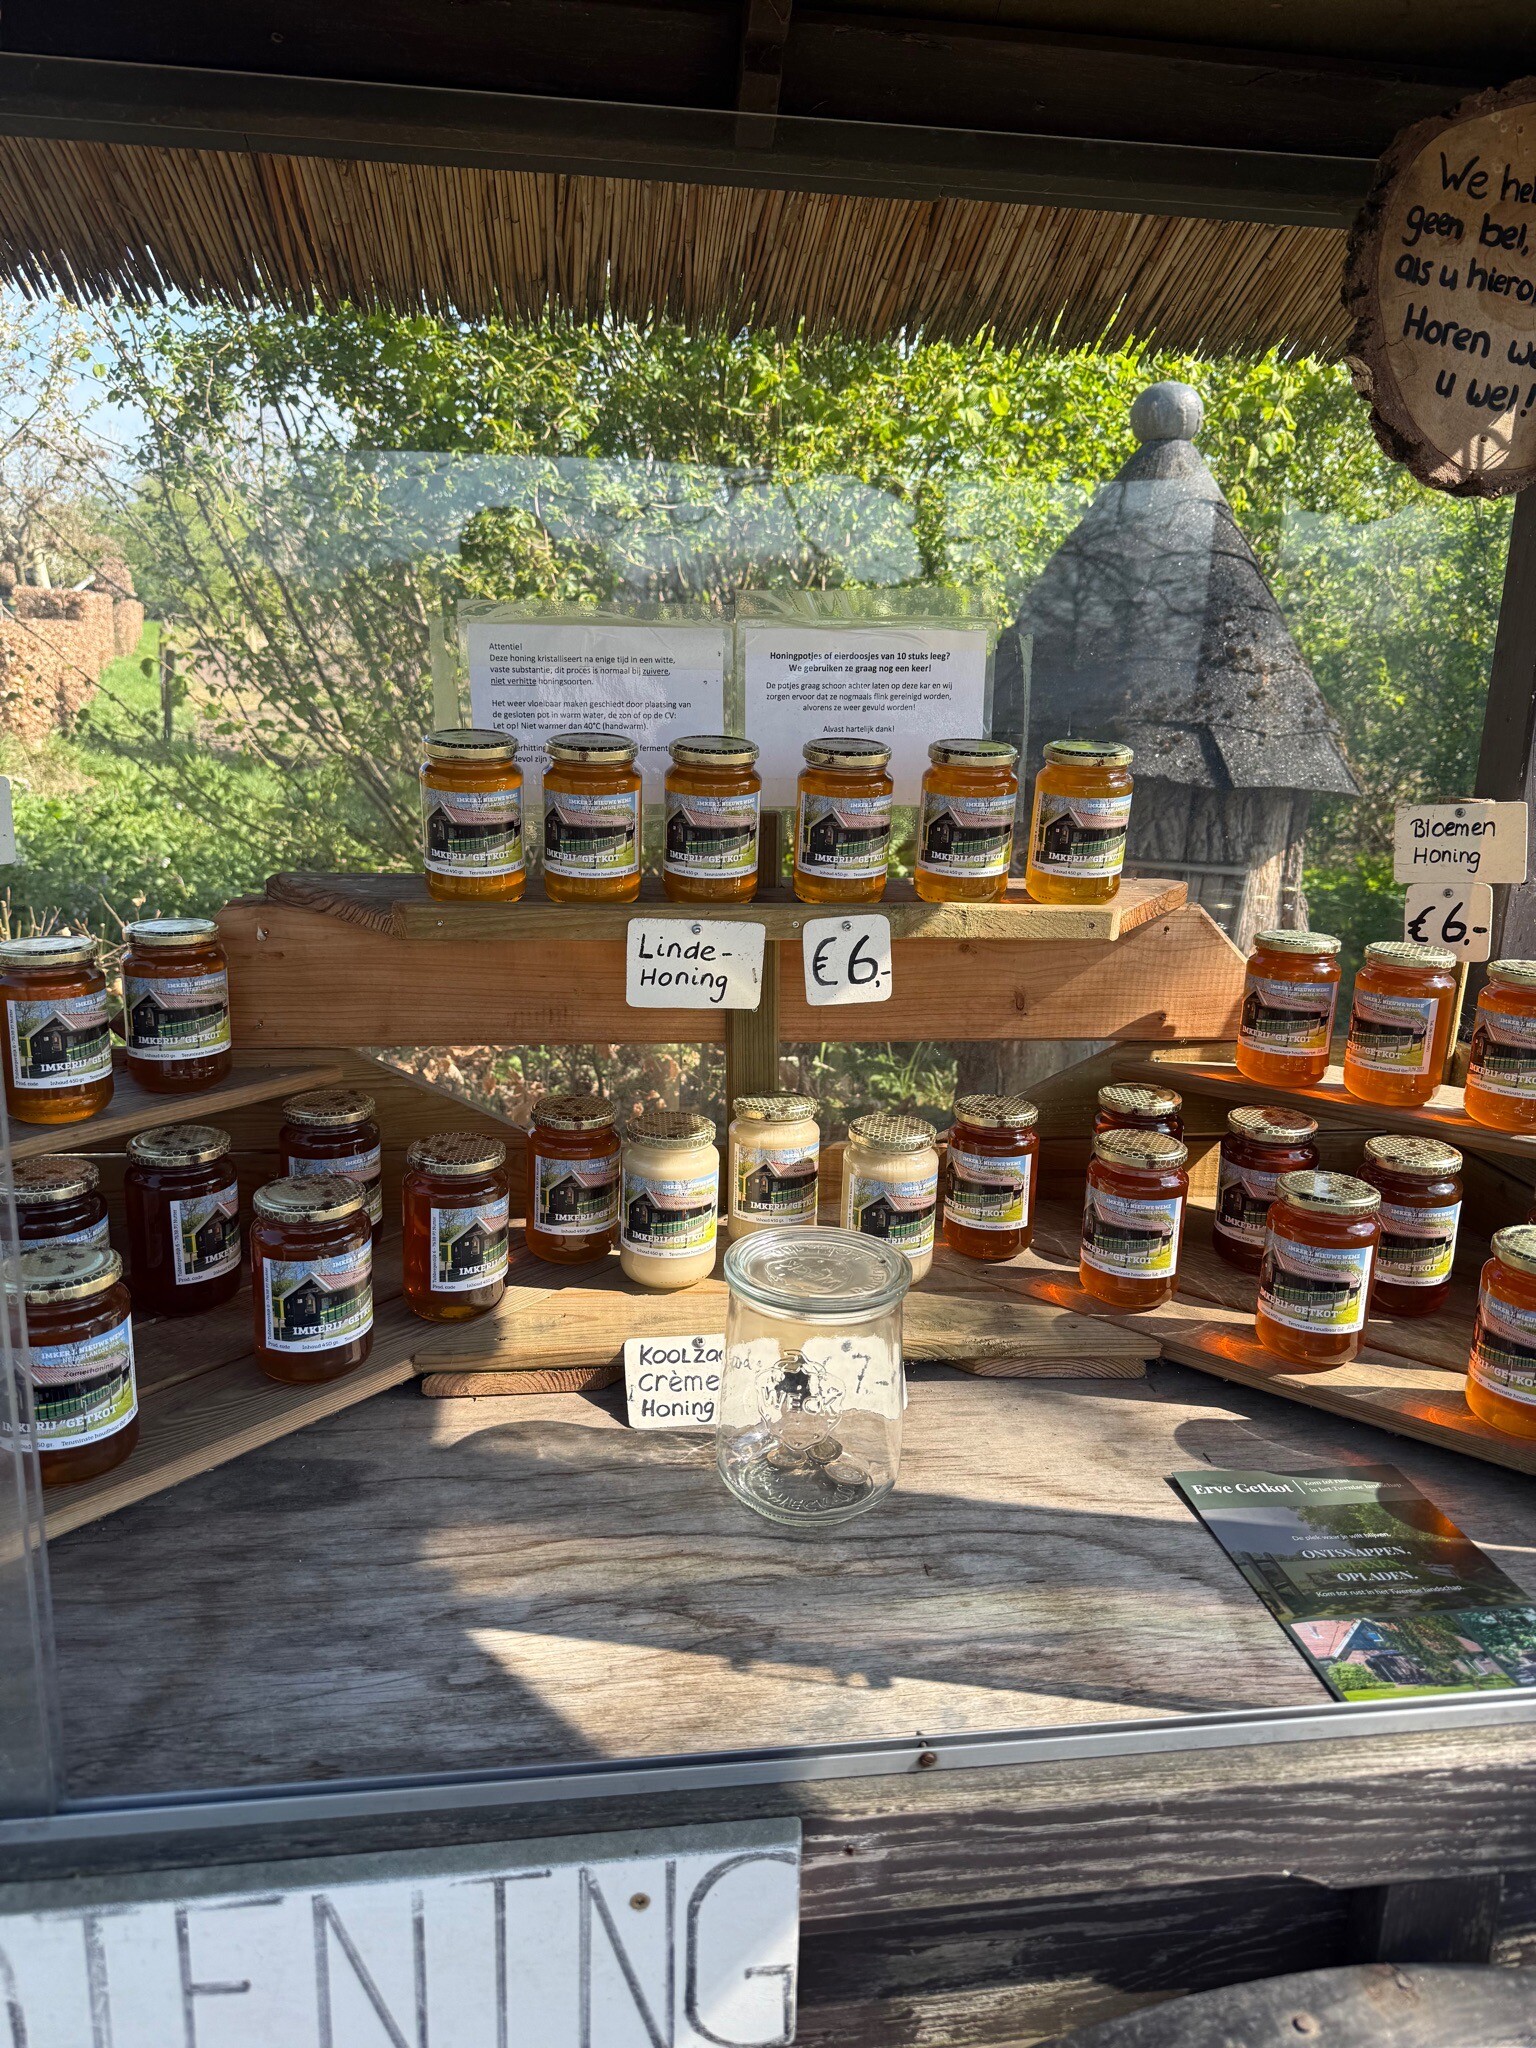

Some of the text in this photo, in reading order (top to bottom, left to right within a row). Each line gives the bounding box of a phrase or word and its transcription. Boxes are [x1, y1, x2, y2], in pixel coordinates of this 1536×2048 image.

[1440, 152, 1536, 204] We he
[1402, 205, 1529, 256] geen bel,
[1395, 254, 1434, 286] als
[1440, 265, 1459, 291] u
[1403, 303, 1491, 358] Horen
[1436, 370, 1457, 398] u
[510, 654, 535, 664] honing
[538, 655, 582, 663] kristalliseert
[596, 656, 615, 665] enige
[617, 656, 628, 664] tijd
[655, 656, 675, 665] witte,
[770, 652, 822, 662] Honingpotjes
[824, 652, 832, 660] of
[834, 652, 879, 661] eierdoosjes
[897, 652, 906, 660] 10
[908, 652, 928, 660] stuks
[930, 652, 950, 662] leeg?
[567, 668, 591, 676] proces
[600, 667, 630, 675] normaal
[632, 667, 641, 676] bij
[643, 668, 670, 676] zuivere,
[804, 665, 843, 674] gebruiken
[855, 666, 877, 674] graag
[879, 666, 893, 674] nog
[538, 678, 593, 686] honingsoorten.
[778, 682, 799, 691] potjes
[801, 683, 820, 691] graag
[943, 682, 953, 690] wij
[839, 693, 872, 702] nogmaals
[890, 693, 922, 702] gereinigd
[924, 693, 952, 701] worden,
[564, 700, 587, 708] maken
[589, 700, 624, 710] geschiedt
[645, 701, 676, 710] plaatsing
[862, 704, 885, 712] gevuld
[504, 711, 535, 720] gesloten
[643, 713, 652, 721] op
[506, 722, 518, 731] op!
[584, 722, 601, 730] 40°C
[602, 722, 649, 731] (handwarm).
[846, 725, 873, 734] hartelijk
[535, 755, 547, 764] zijn
[1410, 819, 1495, 838] Bloemen
[431, 849, 466, 860] IMKERIJ
[546, 848, 575, 861] IMKERIJ
[669, 850, 703, 862] IMKERIJ
[814, 853, 853, 863] IMKERIJ
[931, 851, 968, 863] IMKERIJ
[1049, 851, 1085, 863] IMKERIJ
[1414, 847, 1481, 873] Honing
[639, 934, 732, 961] Linde-
[640, 967, 728, 1003] Honing
[1242, 1025, 1270, 1038] IMKERIJ
[139, 1036, 178, 1044] IMKERIJ
[40, 1059, 87, 1072] IMKERIJ
[751, 1201, 787, 1210] IMKERIJ
[555, 1213, 594, 1222] IMKERIJ
[632, 1231, 668, 1243] IMKERIJ
[293, 1321, 343, 1335] IMKERIJ
[41, 1350, 70, 1360] IMKER
[638, 1367, 720, 1392] Crème
[641, 1397, 714, 1423] Honing
[1191, 1483, 1294, 1495] Erve Getkot
[1390, 1587, 1422, 1595] Twentse
